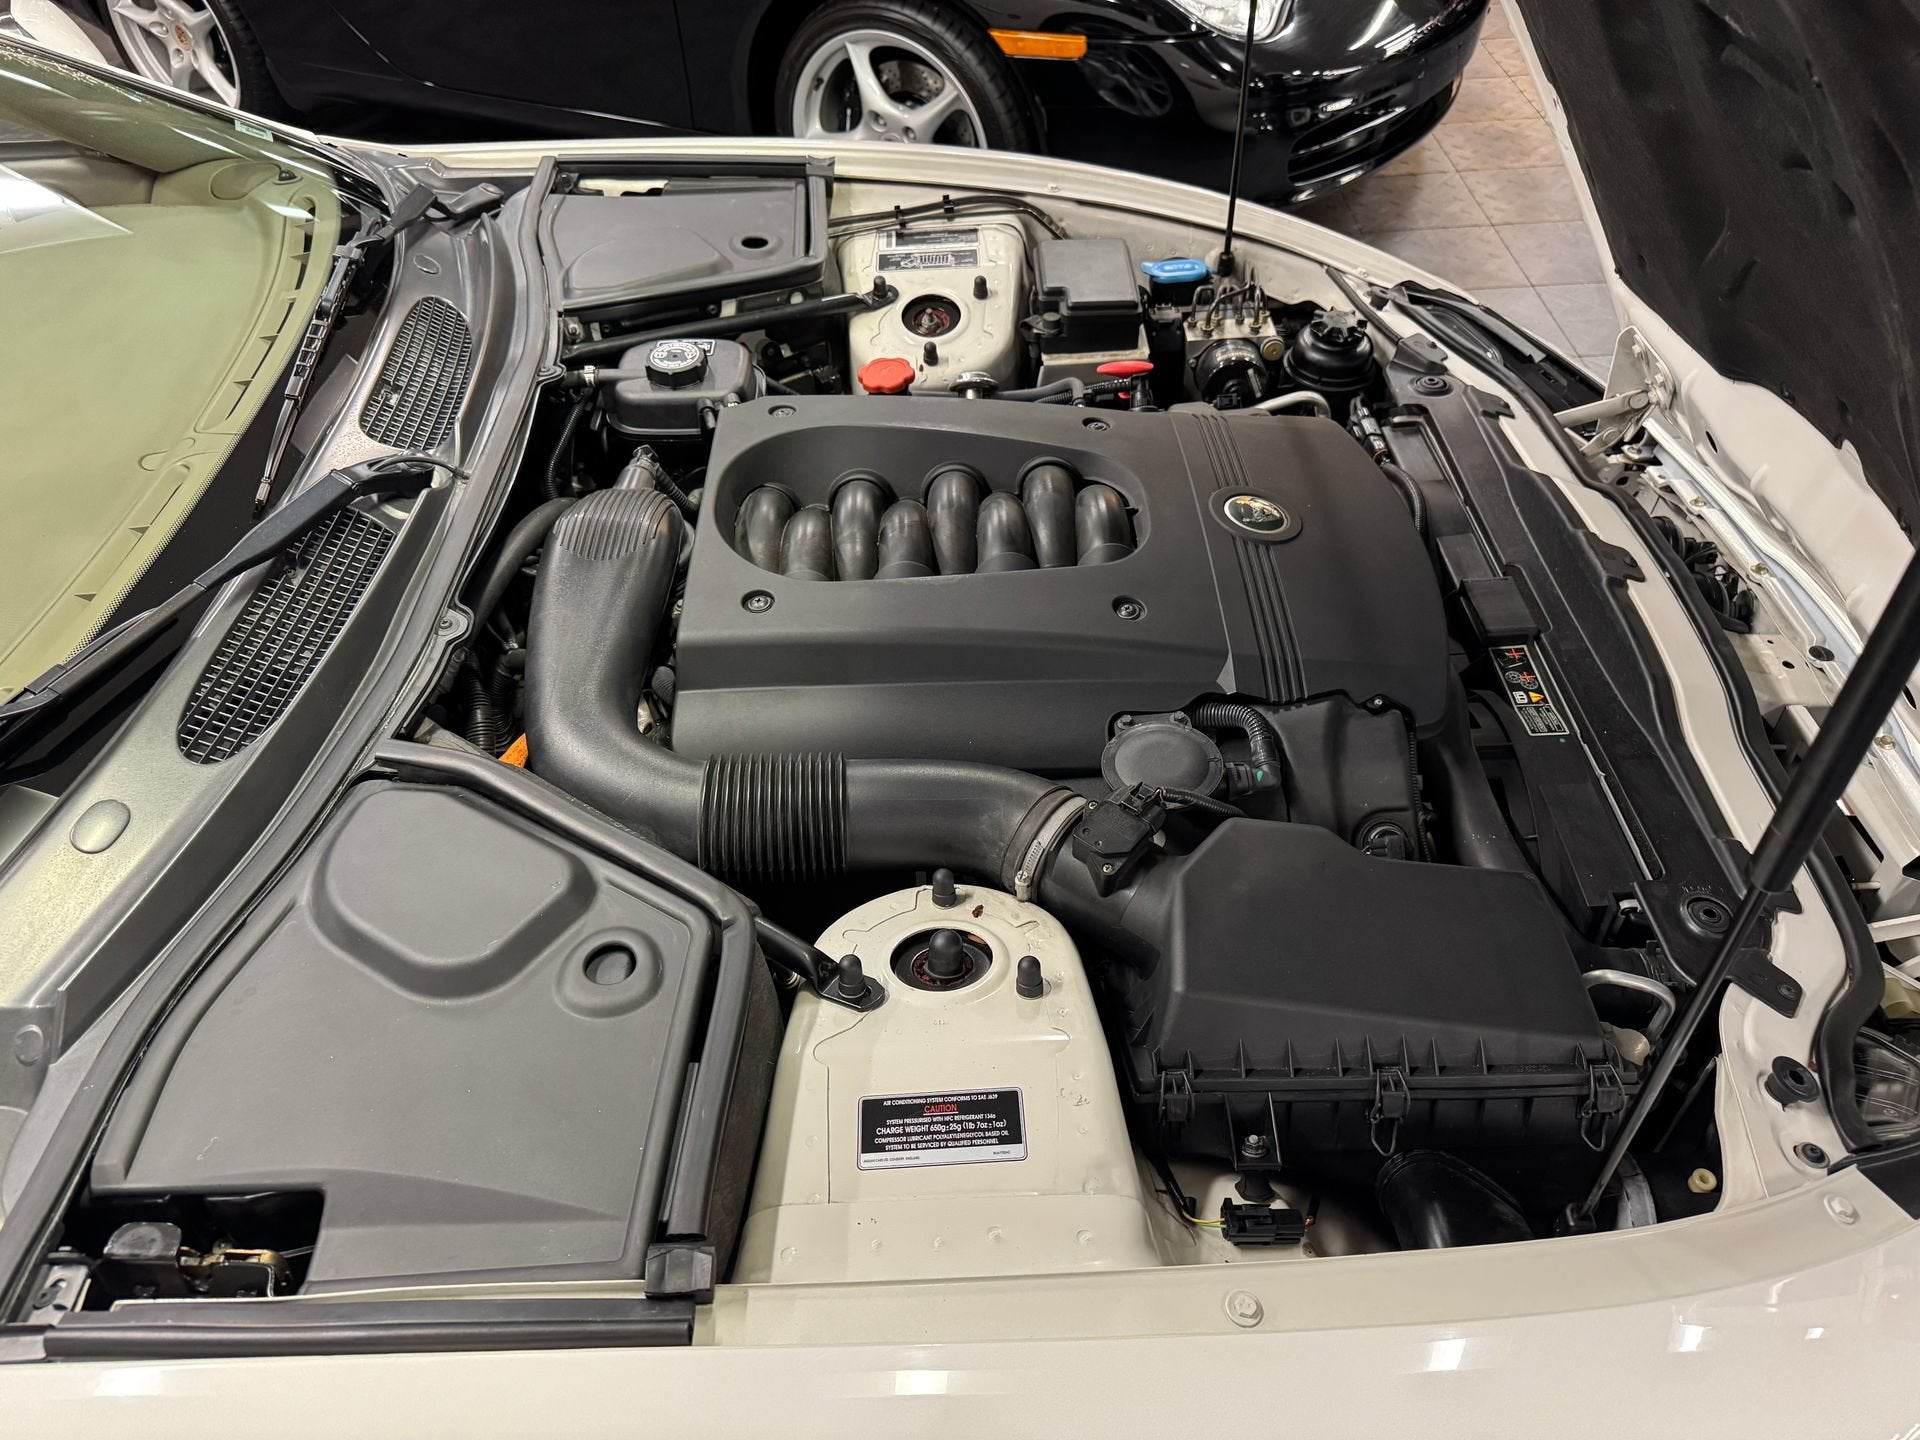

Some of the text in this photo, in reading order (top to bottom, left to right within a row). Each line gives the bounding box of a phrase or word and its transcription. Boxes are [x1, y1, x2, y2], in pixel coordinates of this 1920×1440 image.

[924, 1104, 957, 1113] CAUTION
[876, 1126, 903, 1135] CHARGE
[905, 1125, 929, 1134] WEIGHT
